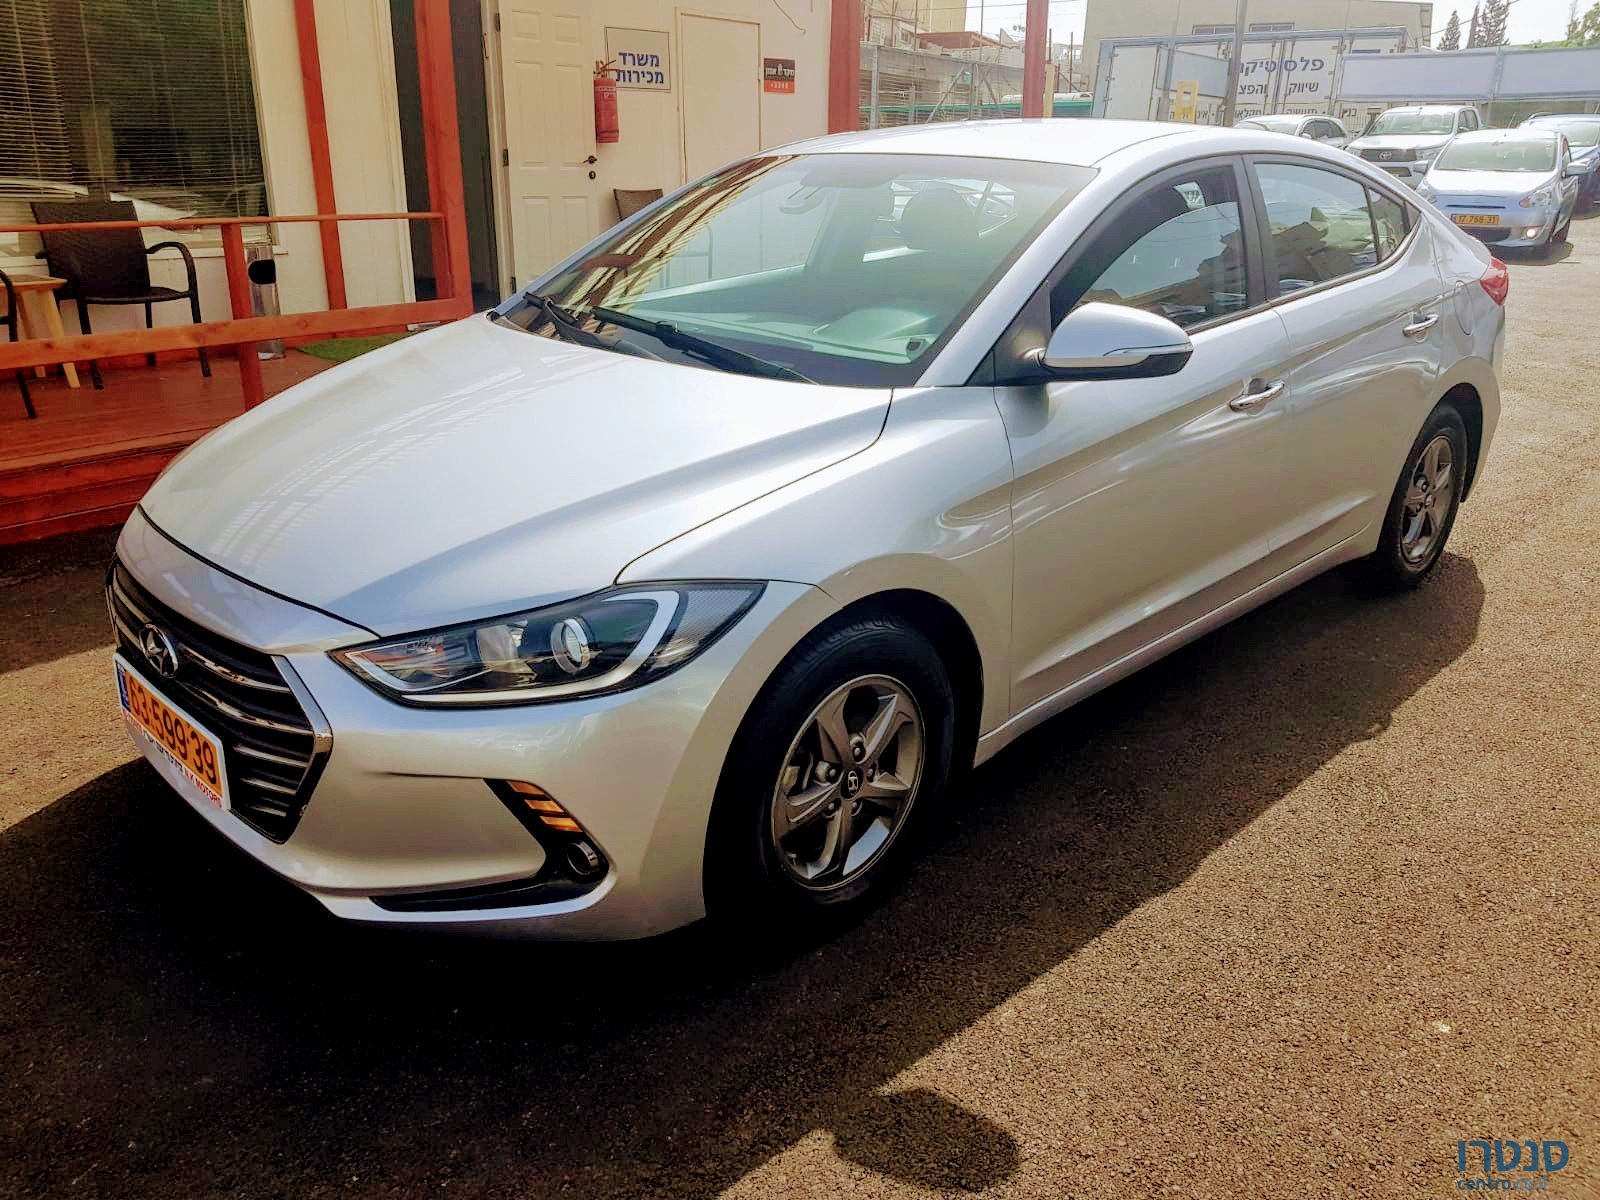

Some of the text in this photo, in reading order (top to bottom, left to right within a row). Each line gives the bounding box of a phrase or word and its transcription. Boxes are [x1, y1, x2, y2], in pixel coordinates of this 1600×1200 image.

[618, 52, 660, 67] משרד
[615, 69, 665, 84] מכירות
[1238, 81, 1319, 96] שיווק והפצ
